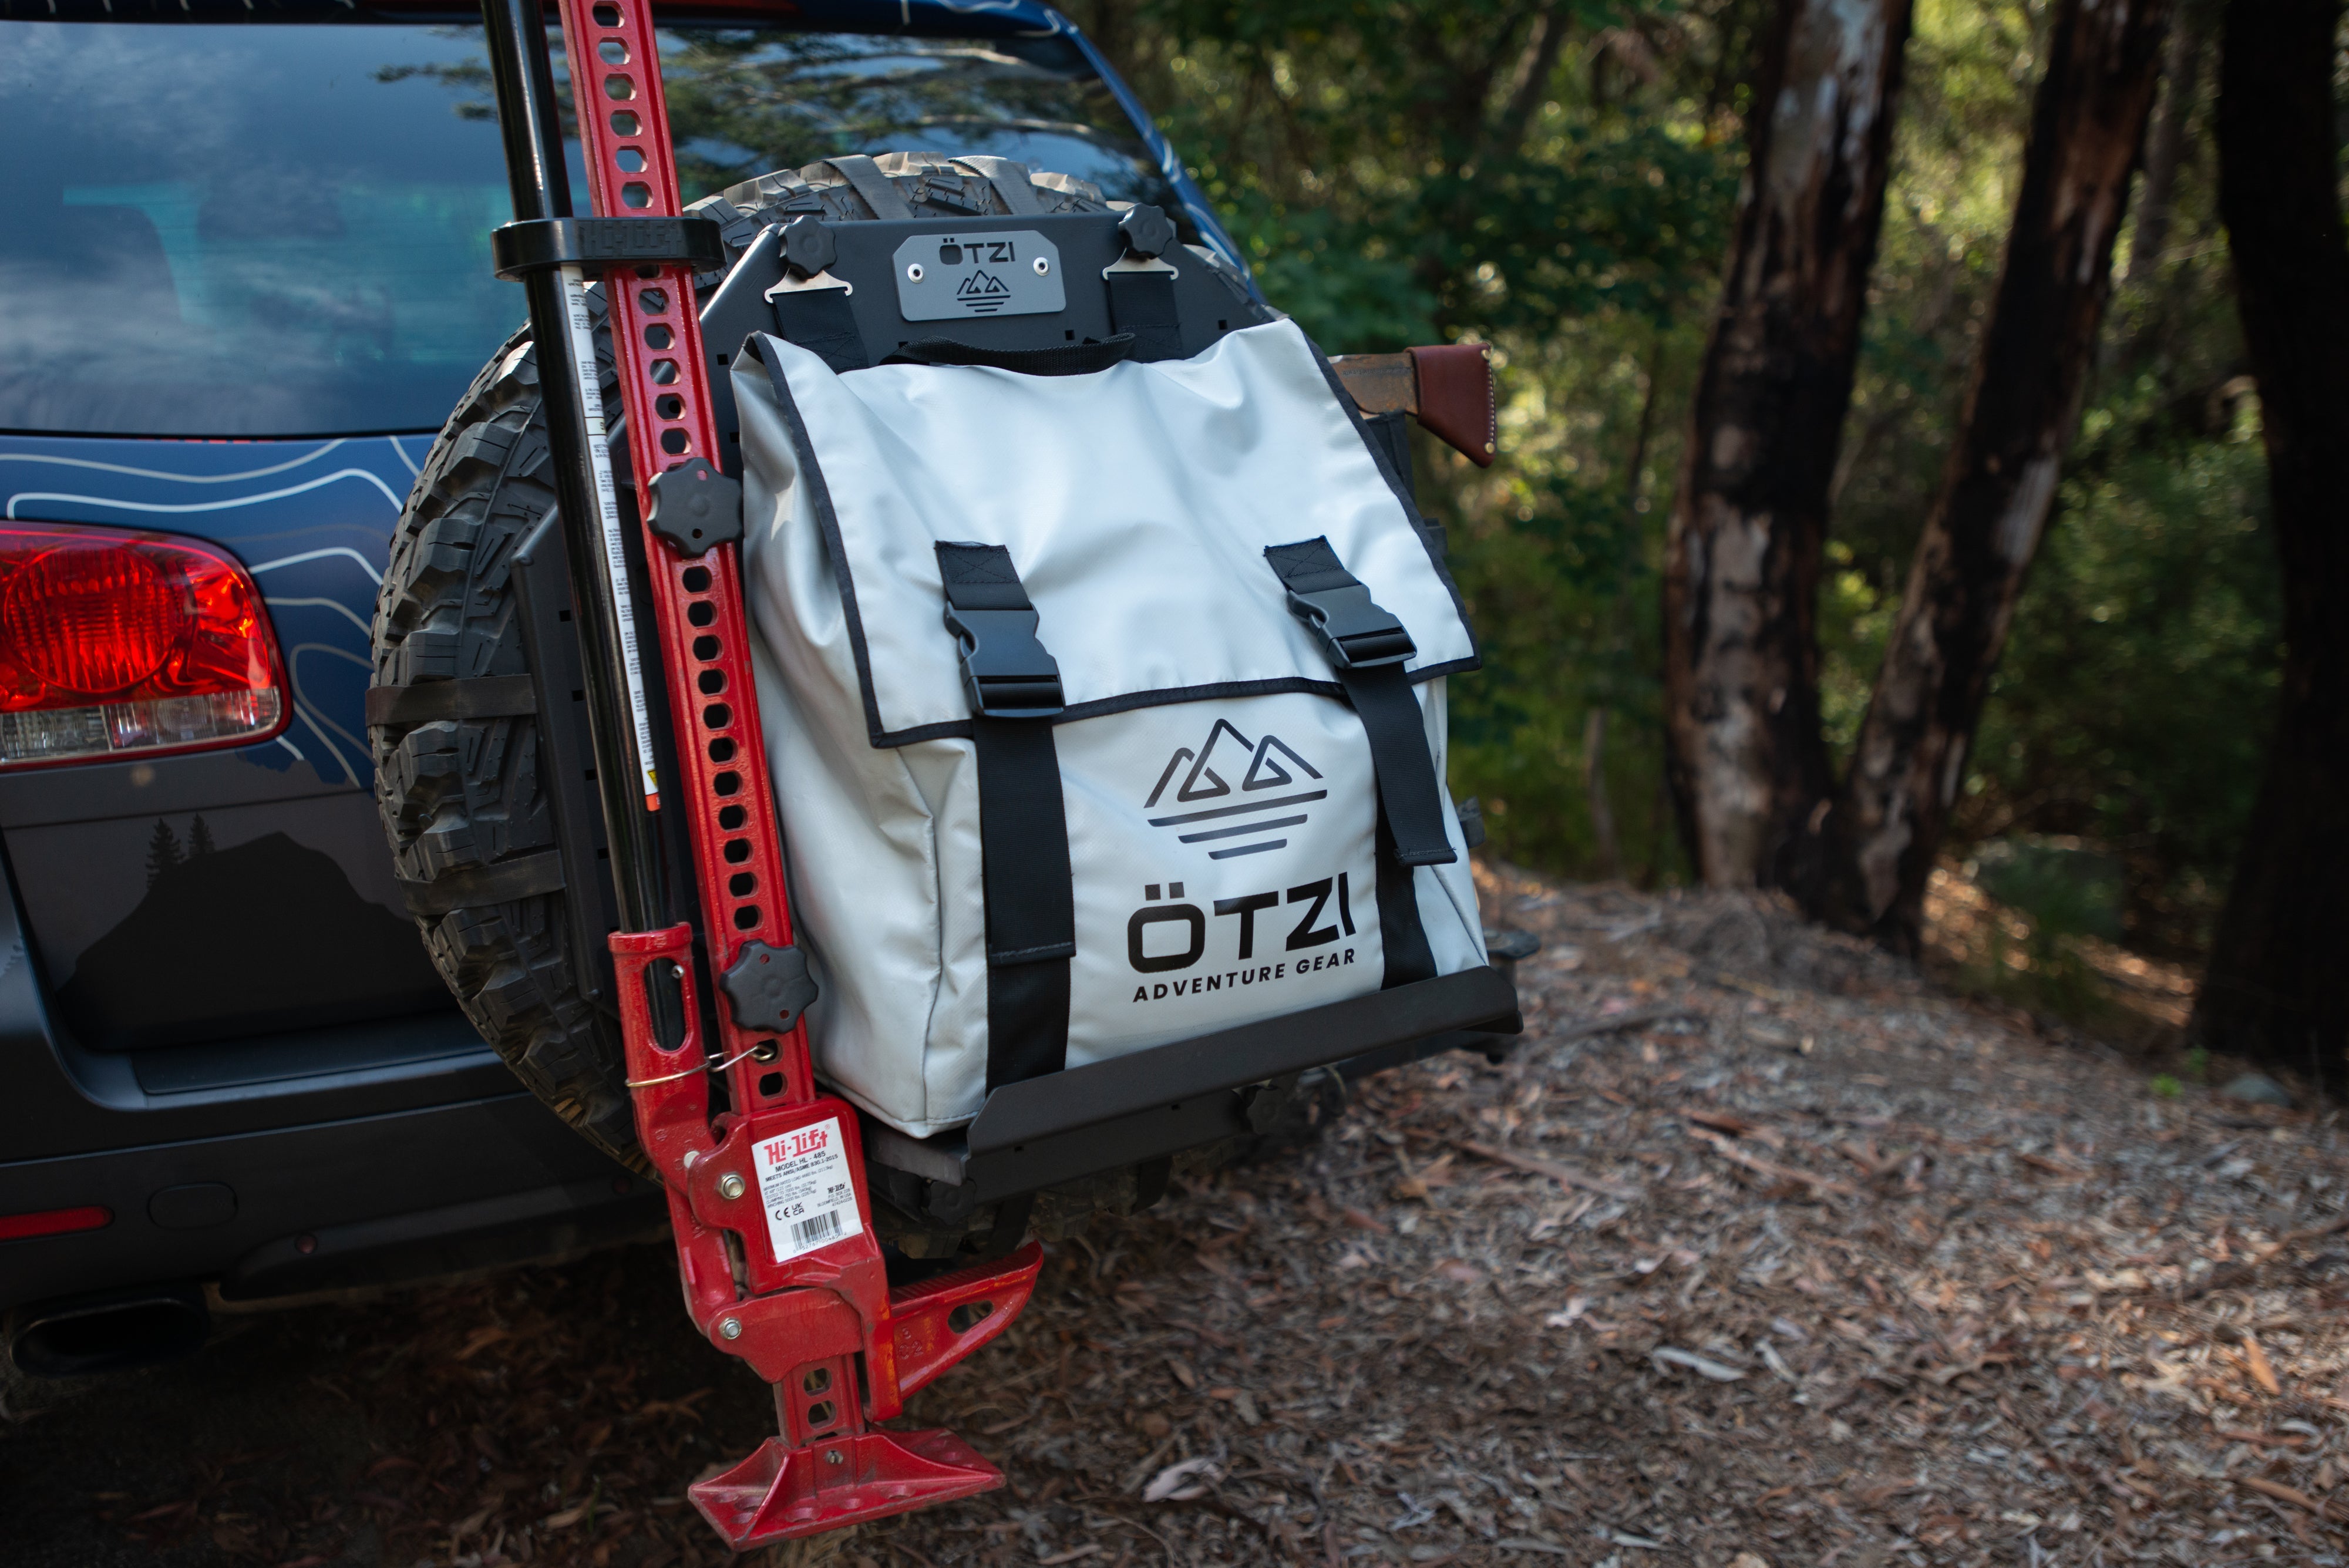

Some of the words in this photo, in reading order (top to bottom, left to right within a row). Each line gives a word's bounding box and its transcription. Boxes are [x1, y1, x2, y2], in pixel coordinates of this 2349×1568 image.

[939, 238, 1015, 265] ÖTZI
[1128, 872, 1356, 973] ÖTZI
[1133, 963, 1285, 1002] ADVENTURE
[1295, 948, 1355, 974] GEAR
[765, 1130, 827, 1165] Hi-Lift
[766, 1173, 782, 1182] MEETS
[783, 1164, 810, 1176] ANSI/ASME
[776, 1161, 798, 1172] MODEL
[775, 1207, 790, 1221] CE
